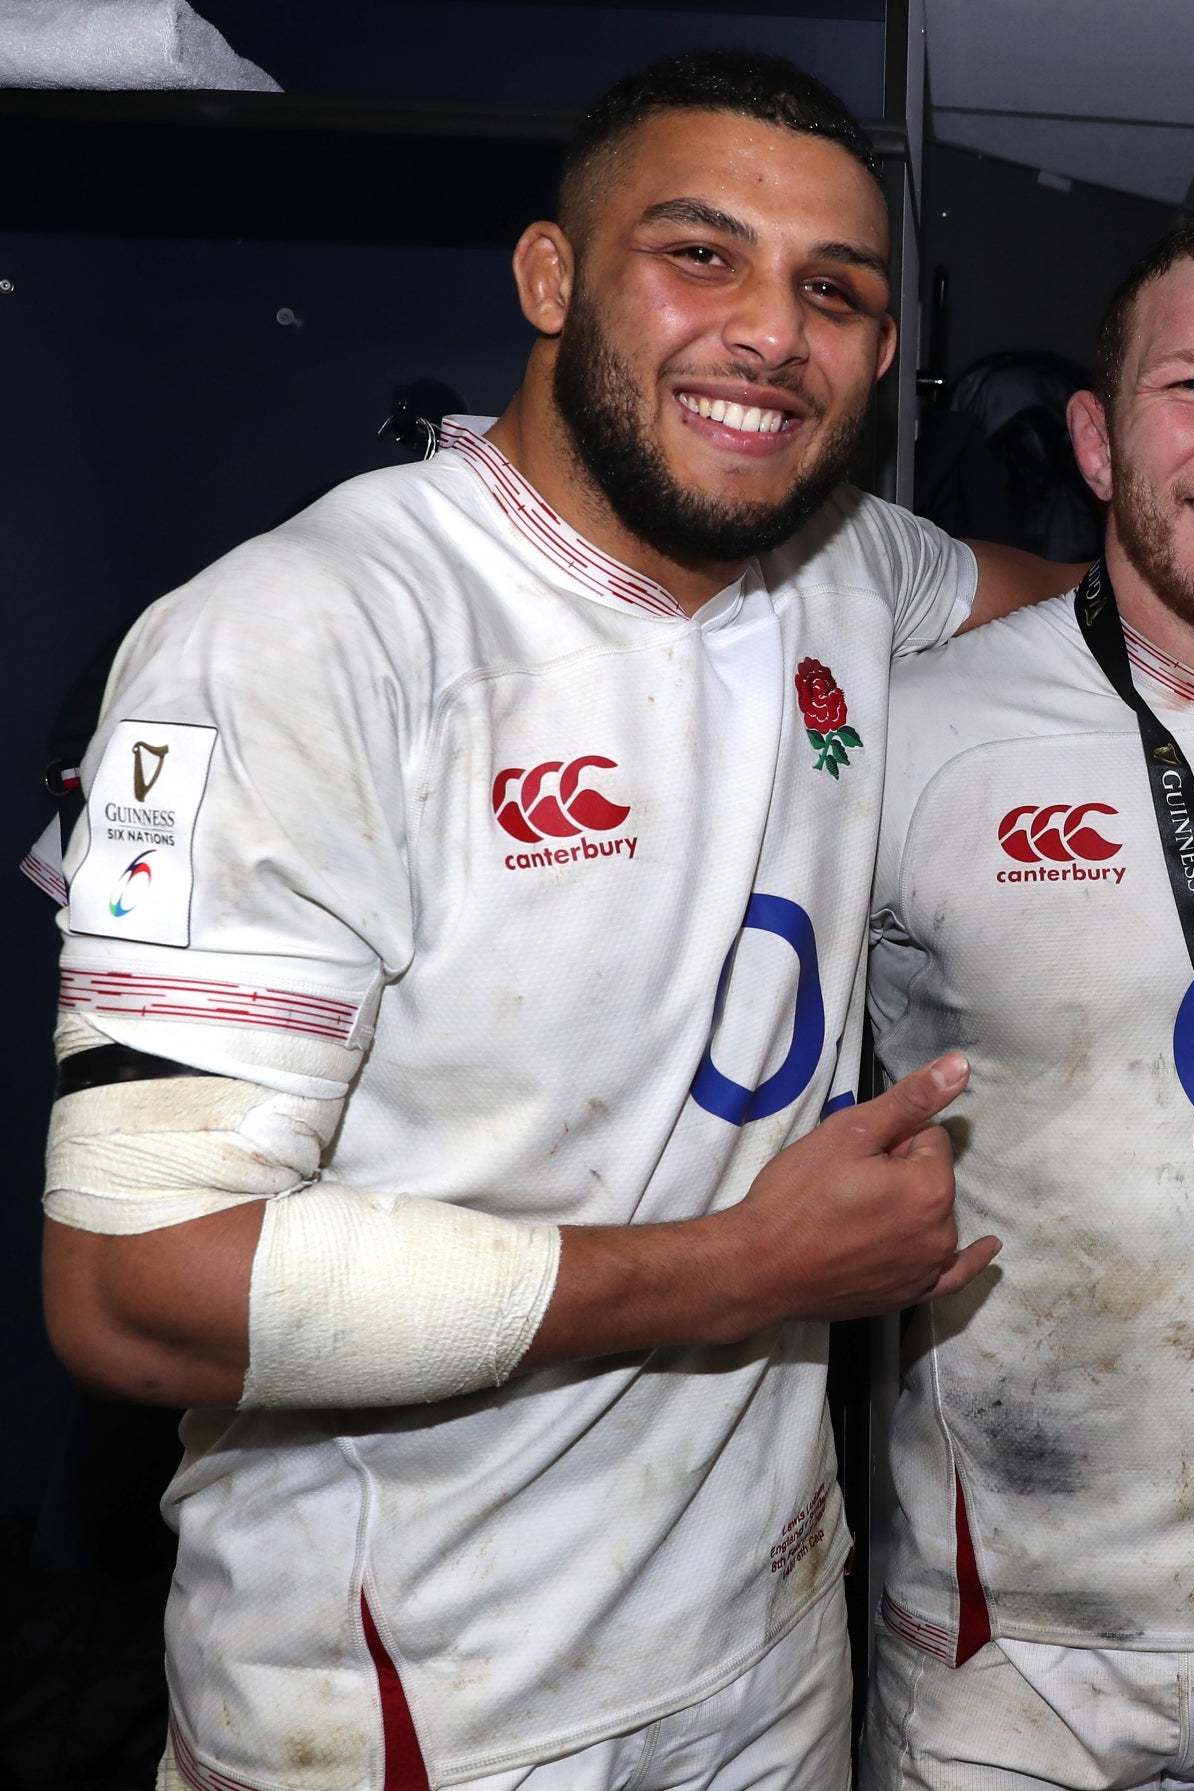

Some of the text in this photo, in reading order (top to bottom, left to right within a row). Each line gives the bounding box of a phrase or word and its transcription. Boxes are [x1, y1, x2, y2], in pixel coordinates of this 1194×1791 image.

[105, 801, 176, 828] GUINNESS
[107, 828, 176, 847] SIX NATIONS
[504, 836, 638, 871] canterbury
[996, 863, 1127, 885] canterbury
